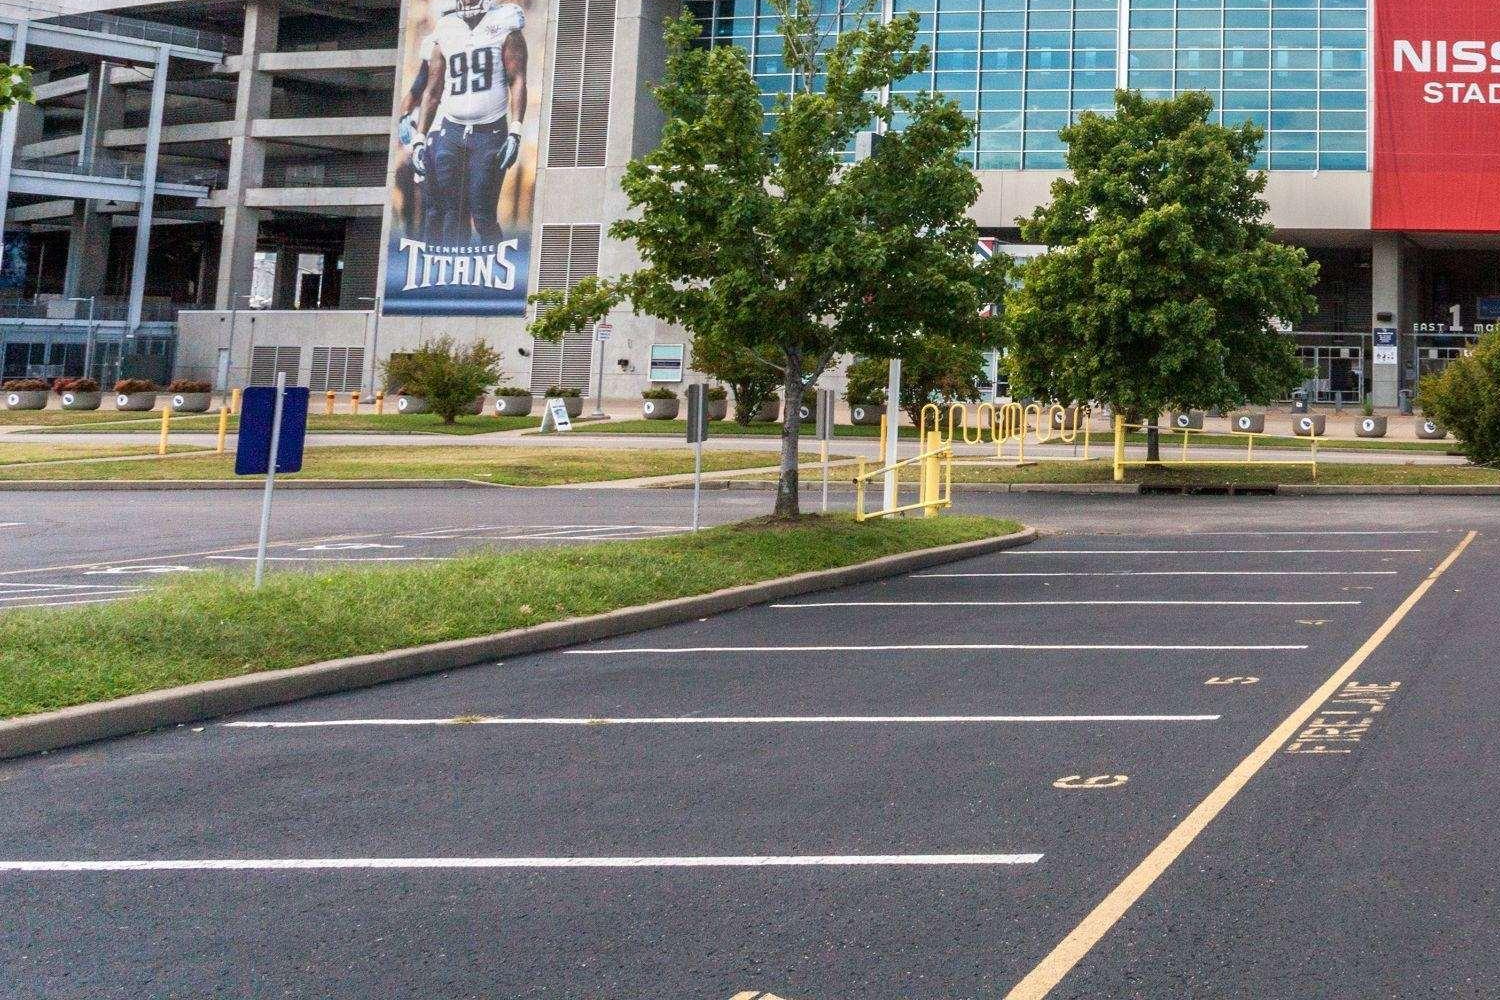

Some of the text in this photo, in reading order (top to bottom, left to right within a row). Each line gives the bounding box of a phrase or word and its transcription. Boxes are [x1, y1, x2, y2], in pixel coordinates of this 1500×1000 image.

[449, 46, 494, 96] 99
[428, 244, 496, 255] TENNESSEE
[399, 237, 519, 292] TITANS
[1413, 323, 1445, 333] EAST
[1449, 304, 1463, 332] 1
[1052, 774, 1129, 789] 6
